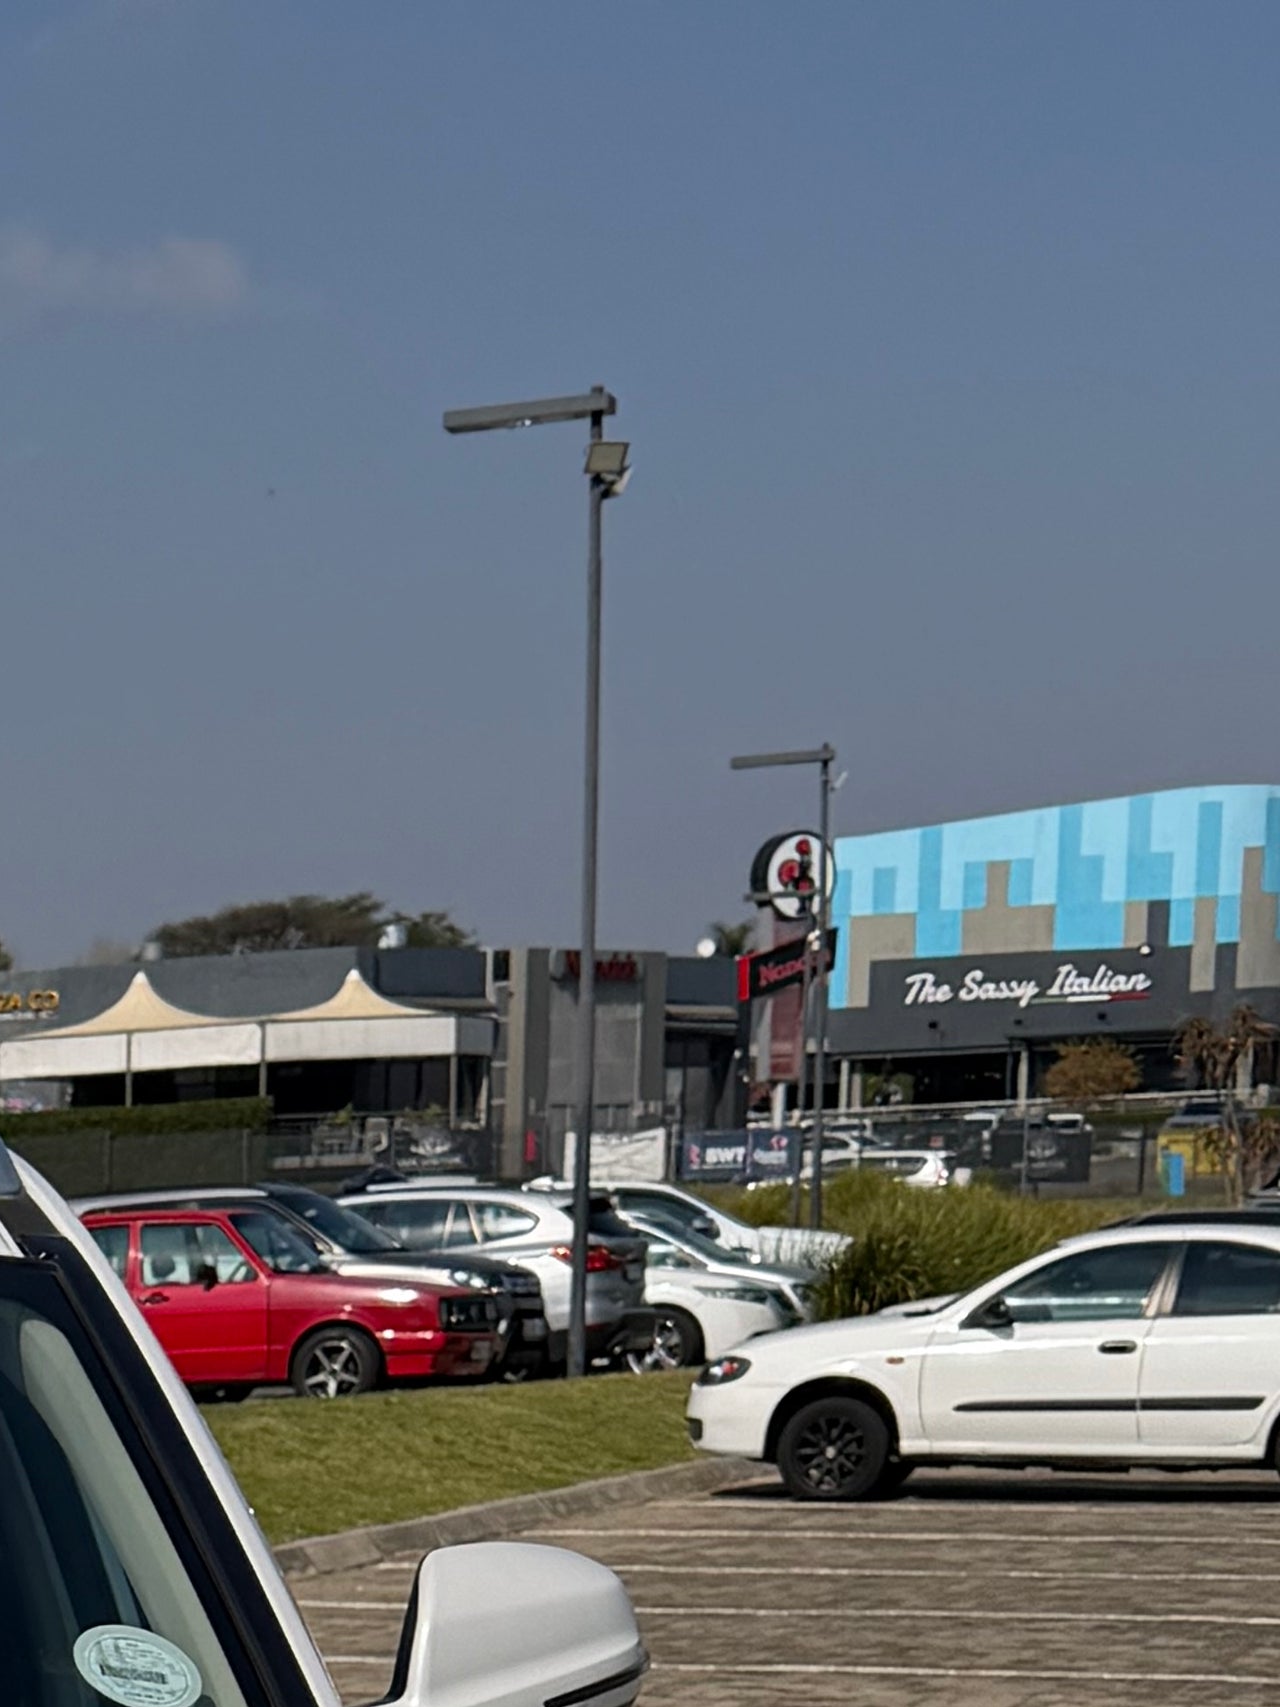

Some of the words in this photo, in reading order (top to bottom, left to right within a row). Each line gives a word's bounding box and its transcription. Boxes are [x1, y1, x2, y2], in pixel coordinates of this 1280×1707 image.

[904, 971, 954, 1005] The
[958, 969, 1040, 1008] Sassy
[1046, 963, 1152, 996] Italian
